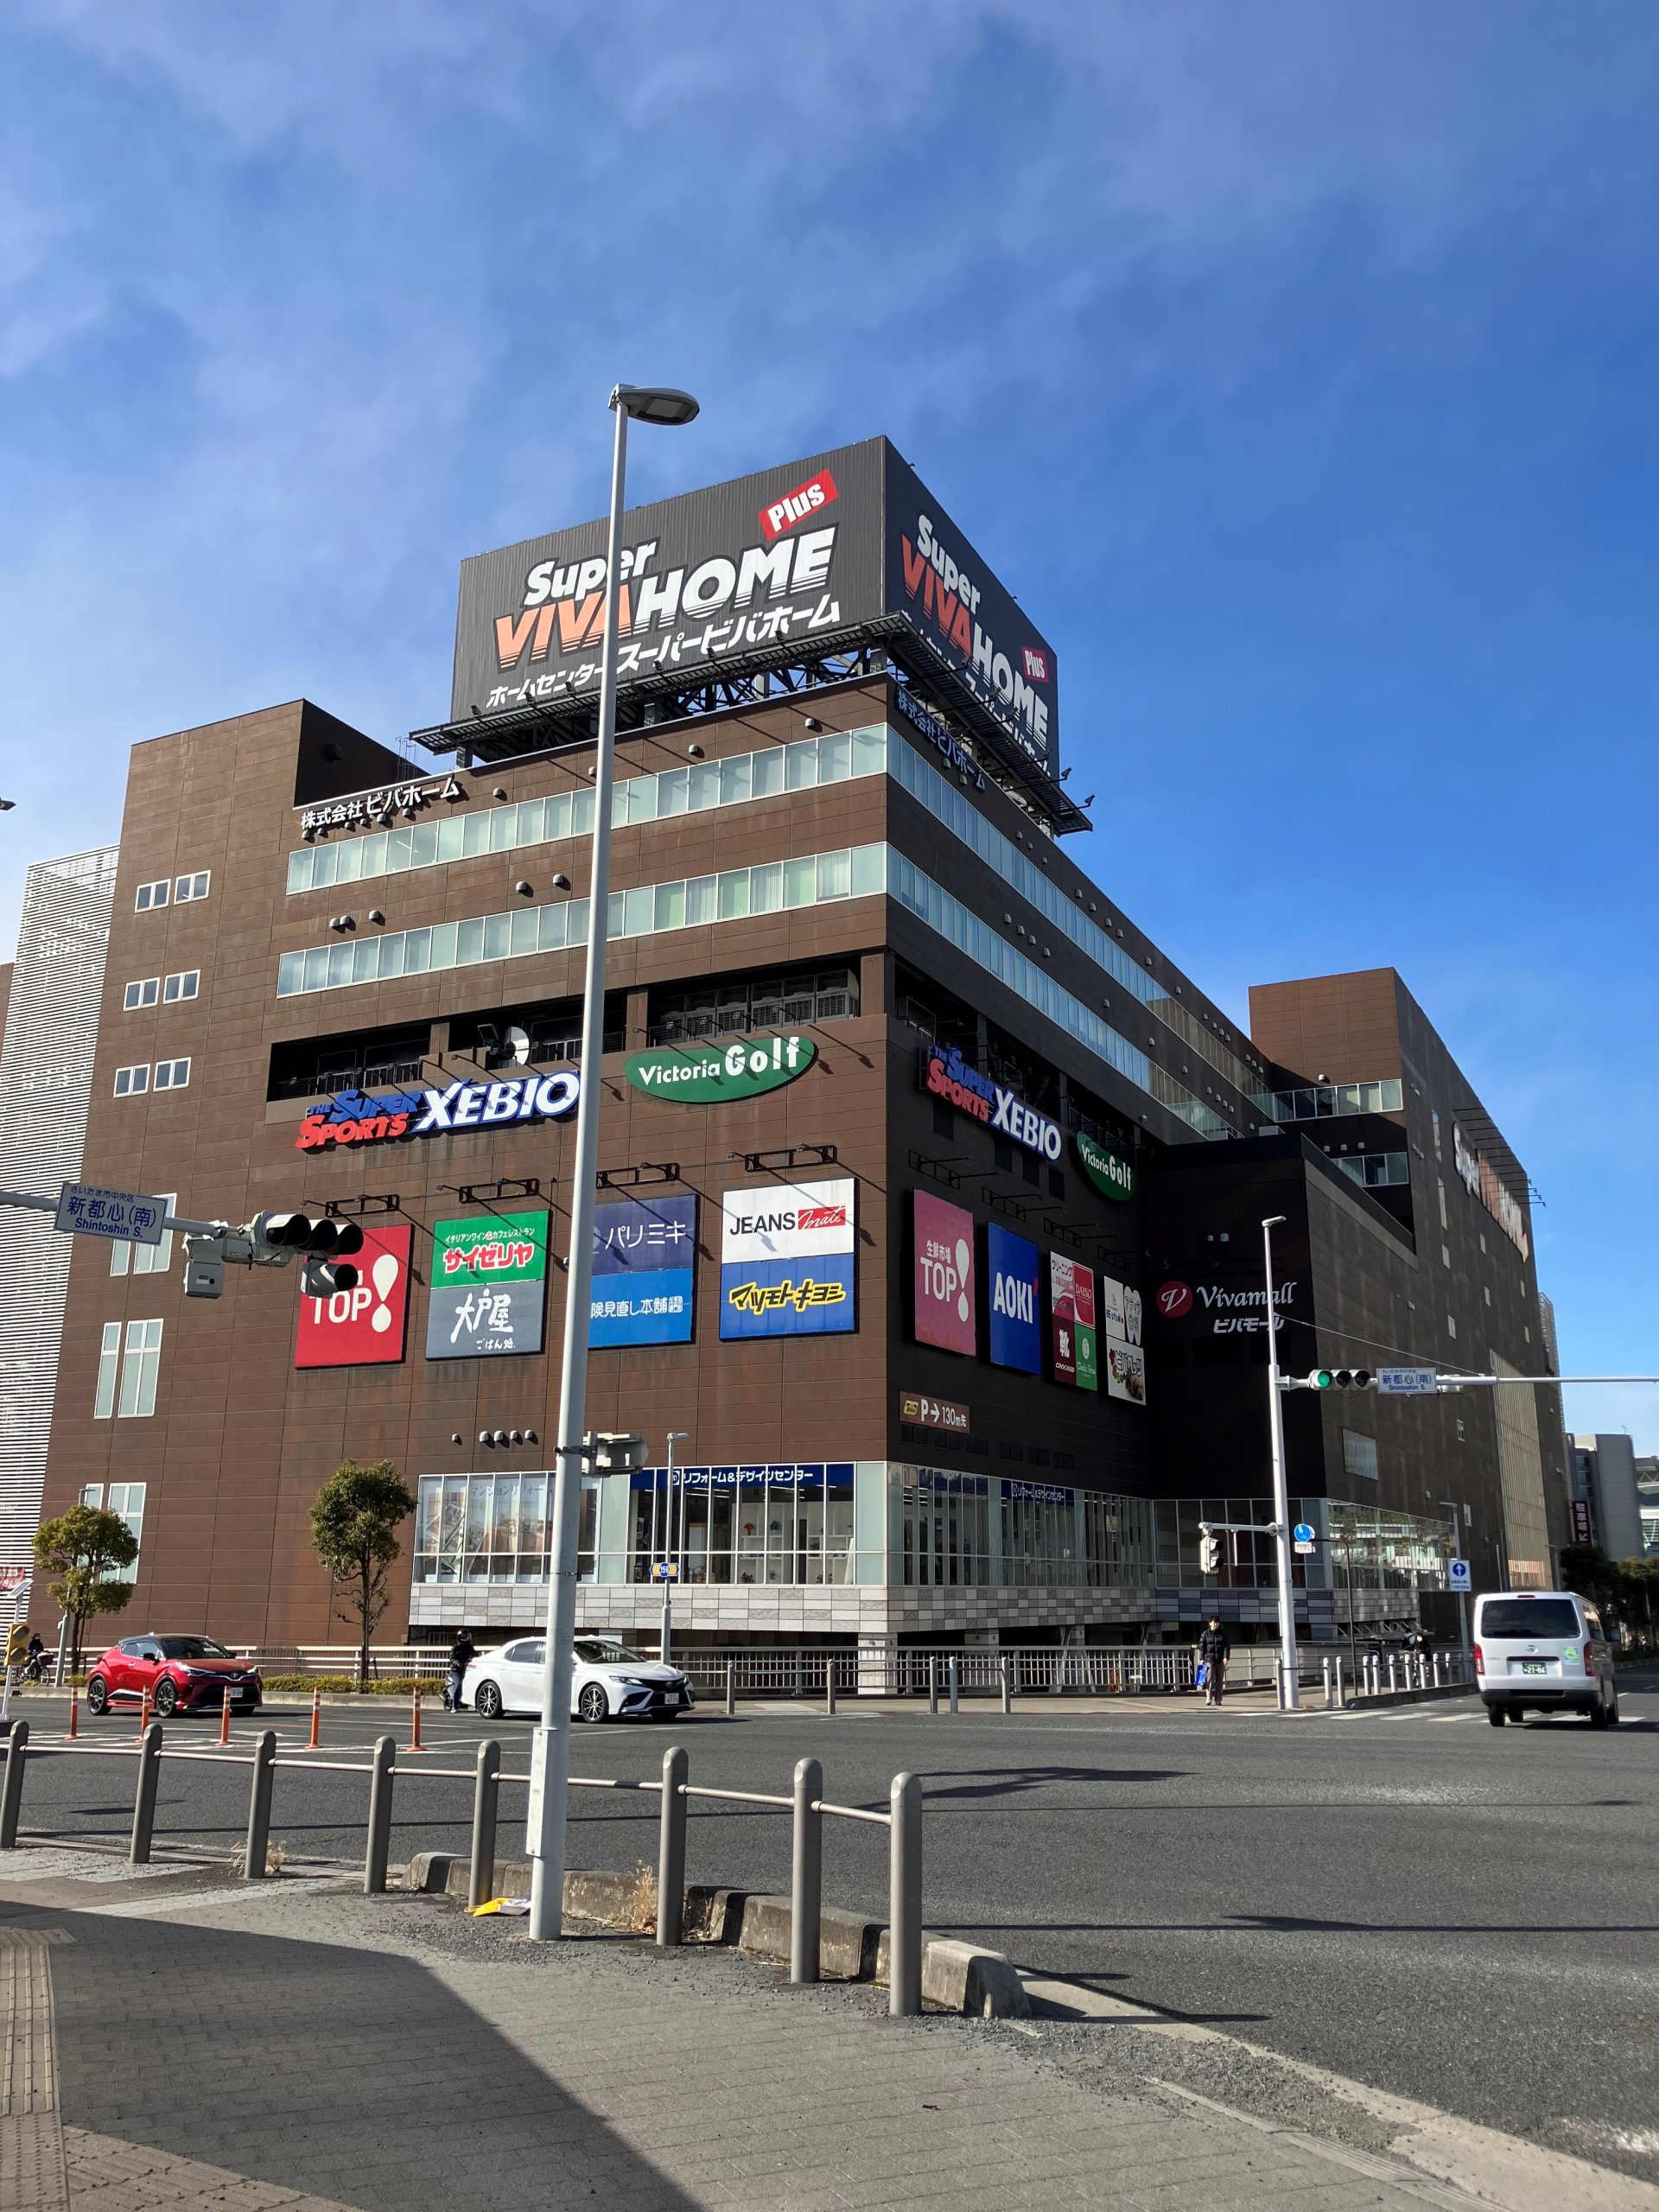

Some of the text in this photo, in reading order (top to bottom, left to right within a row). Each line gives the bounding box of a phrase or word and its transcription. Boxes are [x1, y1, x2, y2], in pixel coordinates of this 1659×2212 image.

[766, 483, 826, 533] Plus
[918, 514, 981, 614] Super
[1024, 650, 1046, 678] Plus
[898, 689, 986, 791] 株式会社ビバホーム
[300, 777, 460, 830] 株式会社ビバホーム
[639, 1036, 800, 1086] Victoria Golf
[308, 1103, 332, 1116] THE
[413, 1071, 581, 1131] XEBIO
[993, 1087, 1062, 1160] XEBIO
[1081, 1144, 1131, 1191] Victoria Golf
[70, 1185, 135, 1203] さいたま市中央区
[74, 1217, 143, 1238] Shintoshin S.
[605, 1220, 686, 1249] パリミキ
[729, 1211, 796, 1236] JEANS
[443, 1242, 535, 1274] サイゼリヤ
[926, 1239, 952, 1264] 生鮮市場
[729, 1279, 847, 1316] マツモトキヨシ
[993, 1271, 1033, 1325] AOKI
[1075, 1283, 1092, 1300] DAISO
[450, 1287, 514, 1344] 大戸屋
[590, 1297, 668, 1319] 険見直し本舗
[1213, 1317, 1285, 1334] ビバモール
[920, 1398, 929, 1422] P
[659, 1565, 670, 1574] 159
